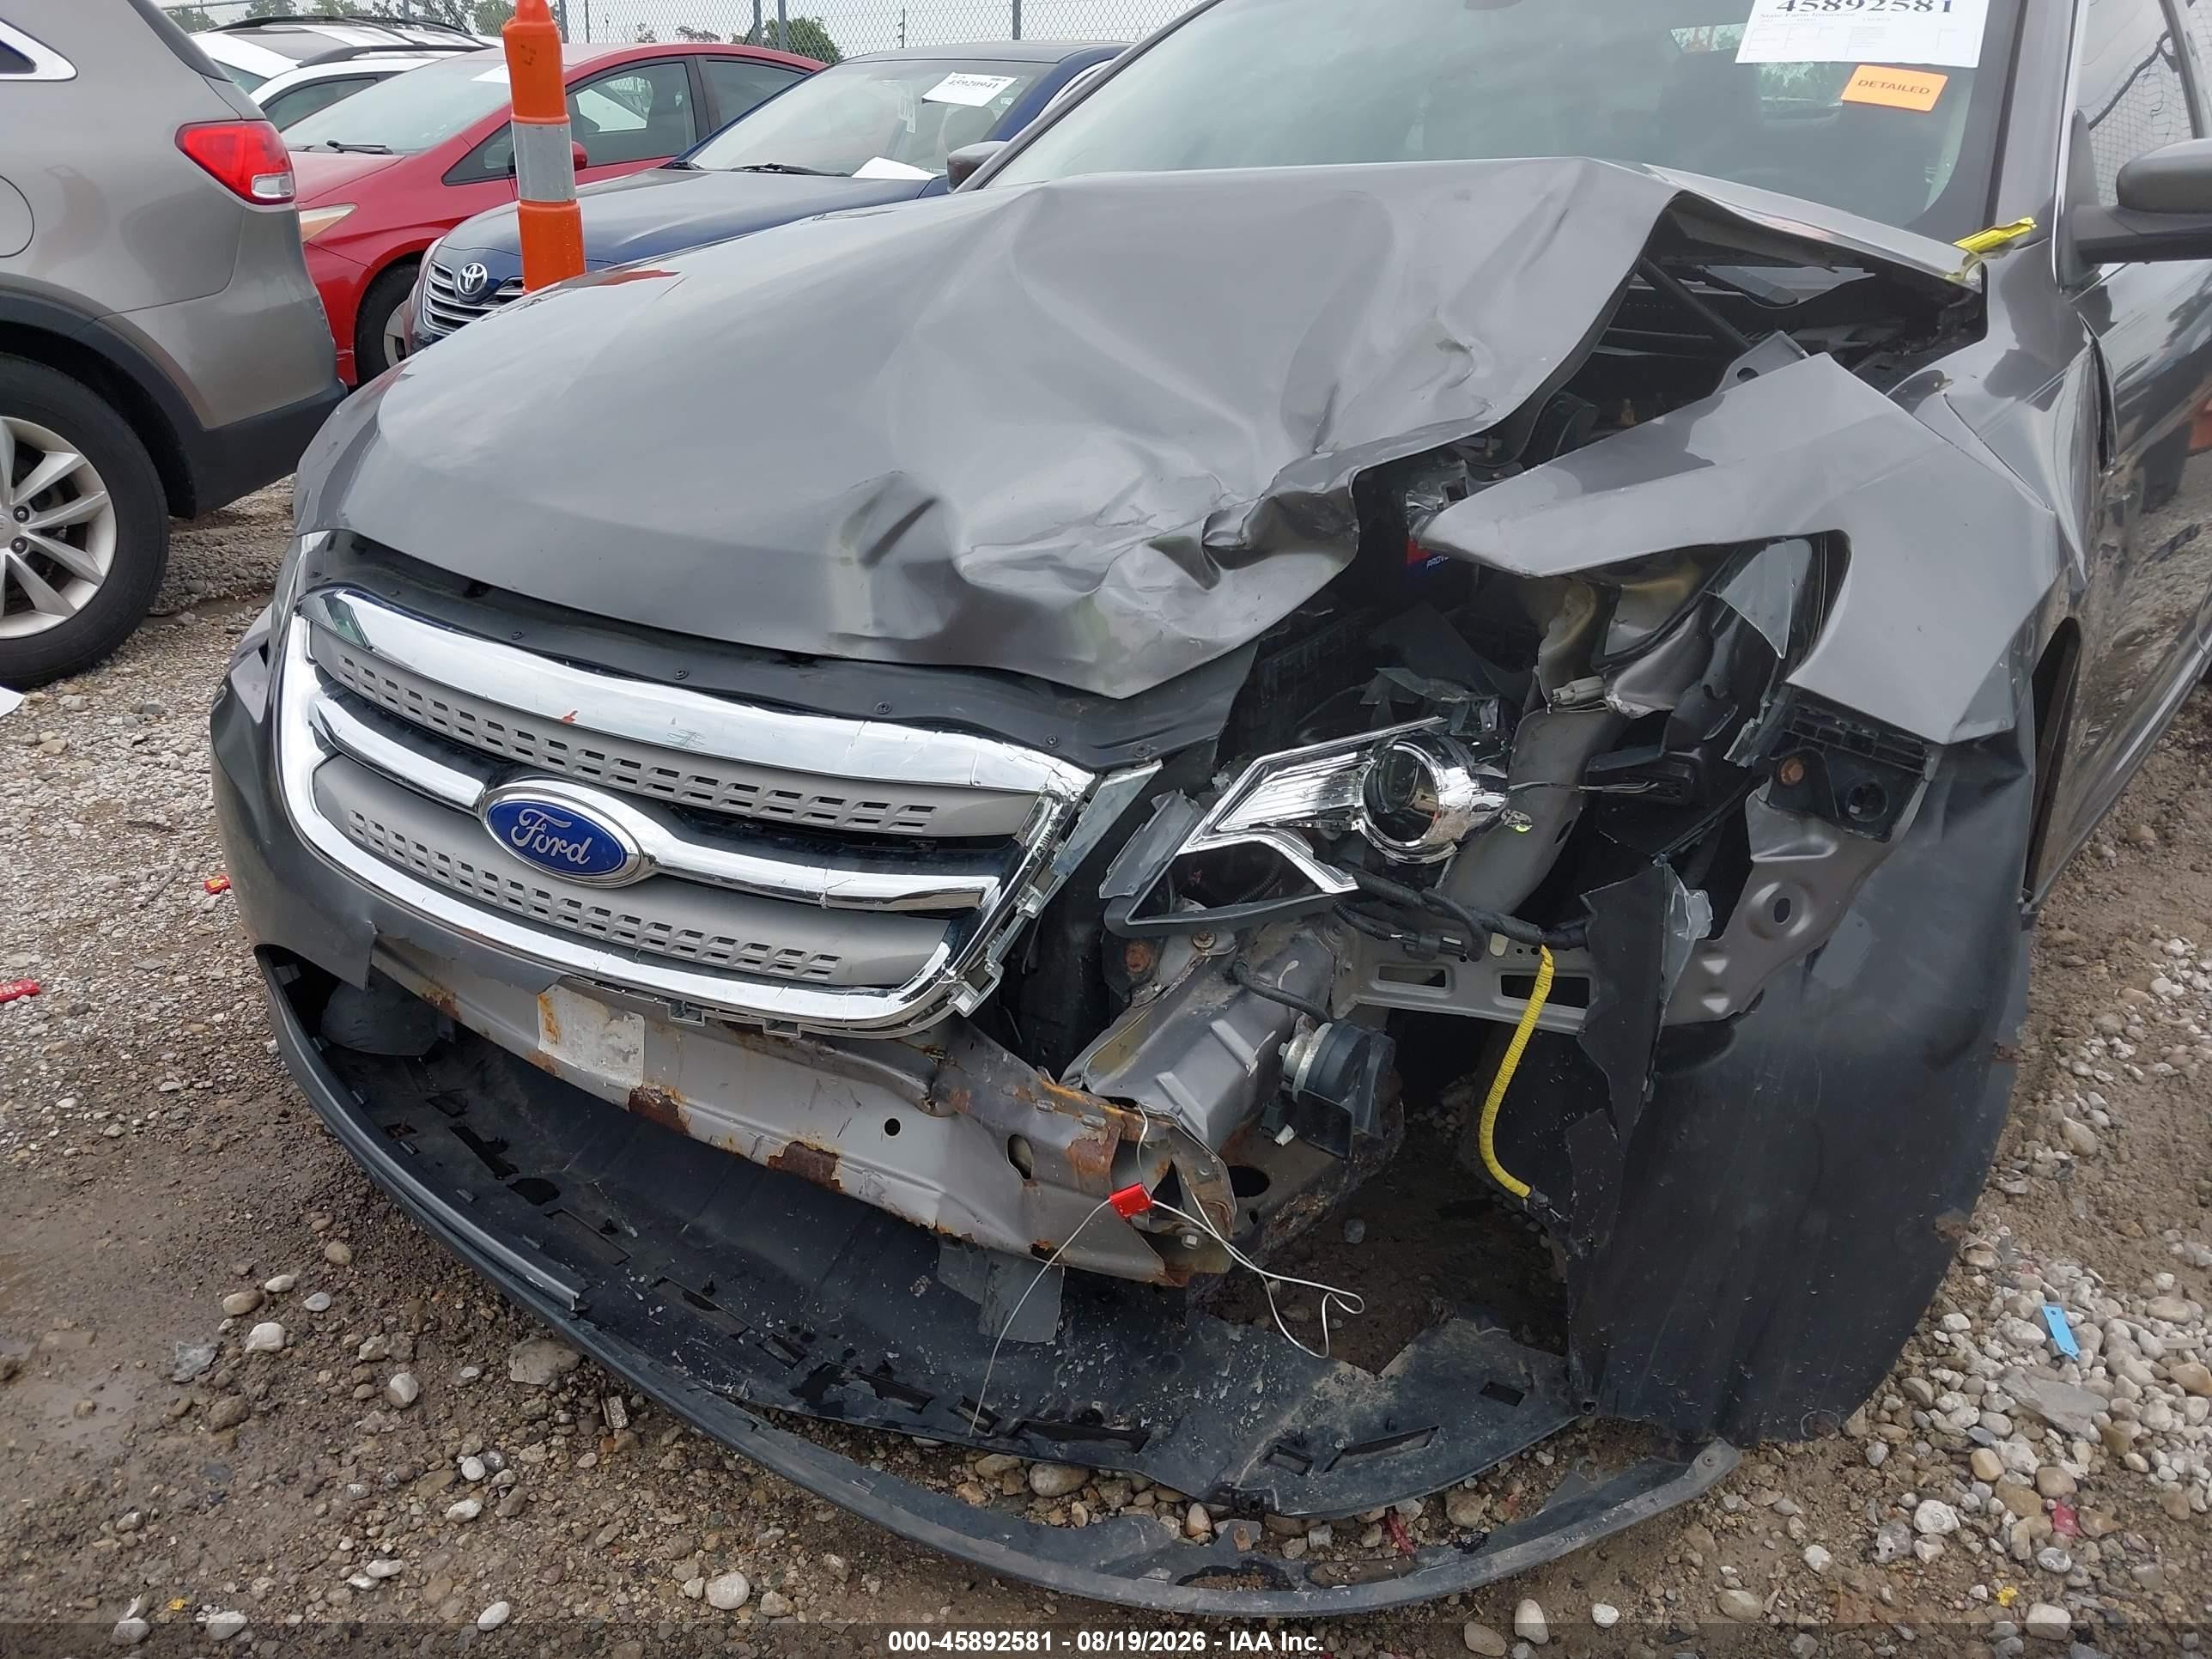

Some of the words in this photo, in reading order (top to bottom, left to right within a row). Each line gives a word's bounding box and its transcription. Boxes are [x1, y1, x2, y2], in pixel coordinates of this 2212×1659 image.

[1776, 0, 1954, 13] 45892581
[1857, 79, 1930, 94] DETAILED
[510, 808, 593, 865] Ford
